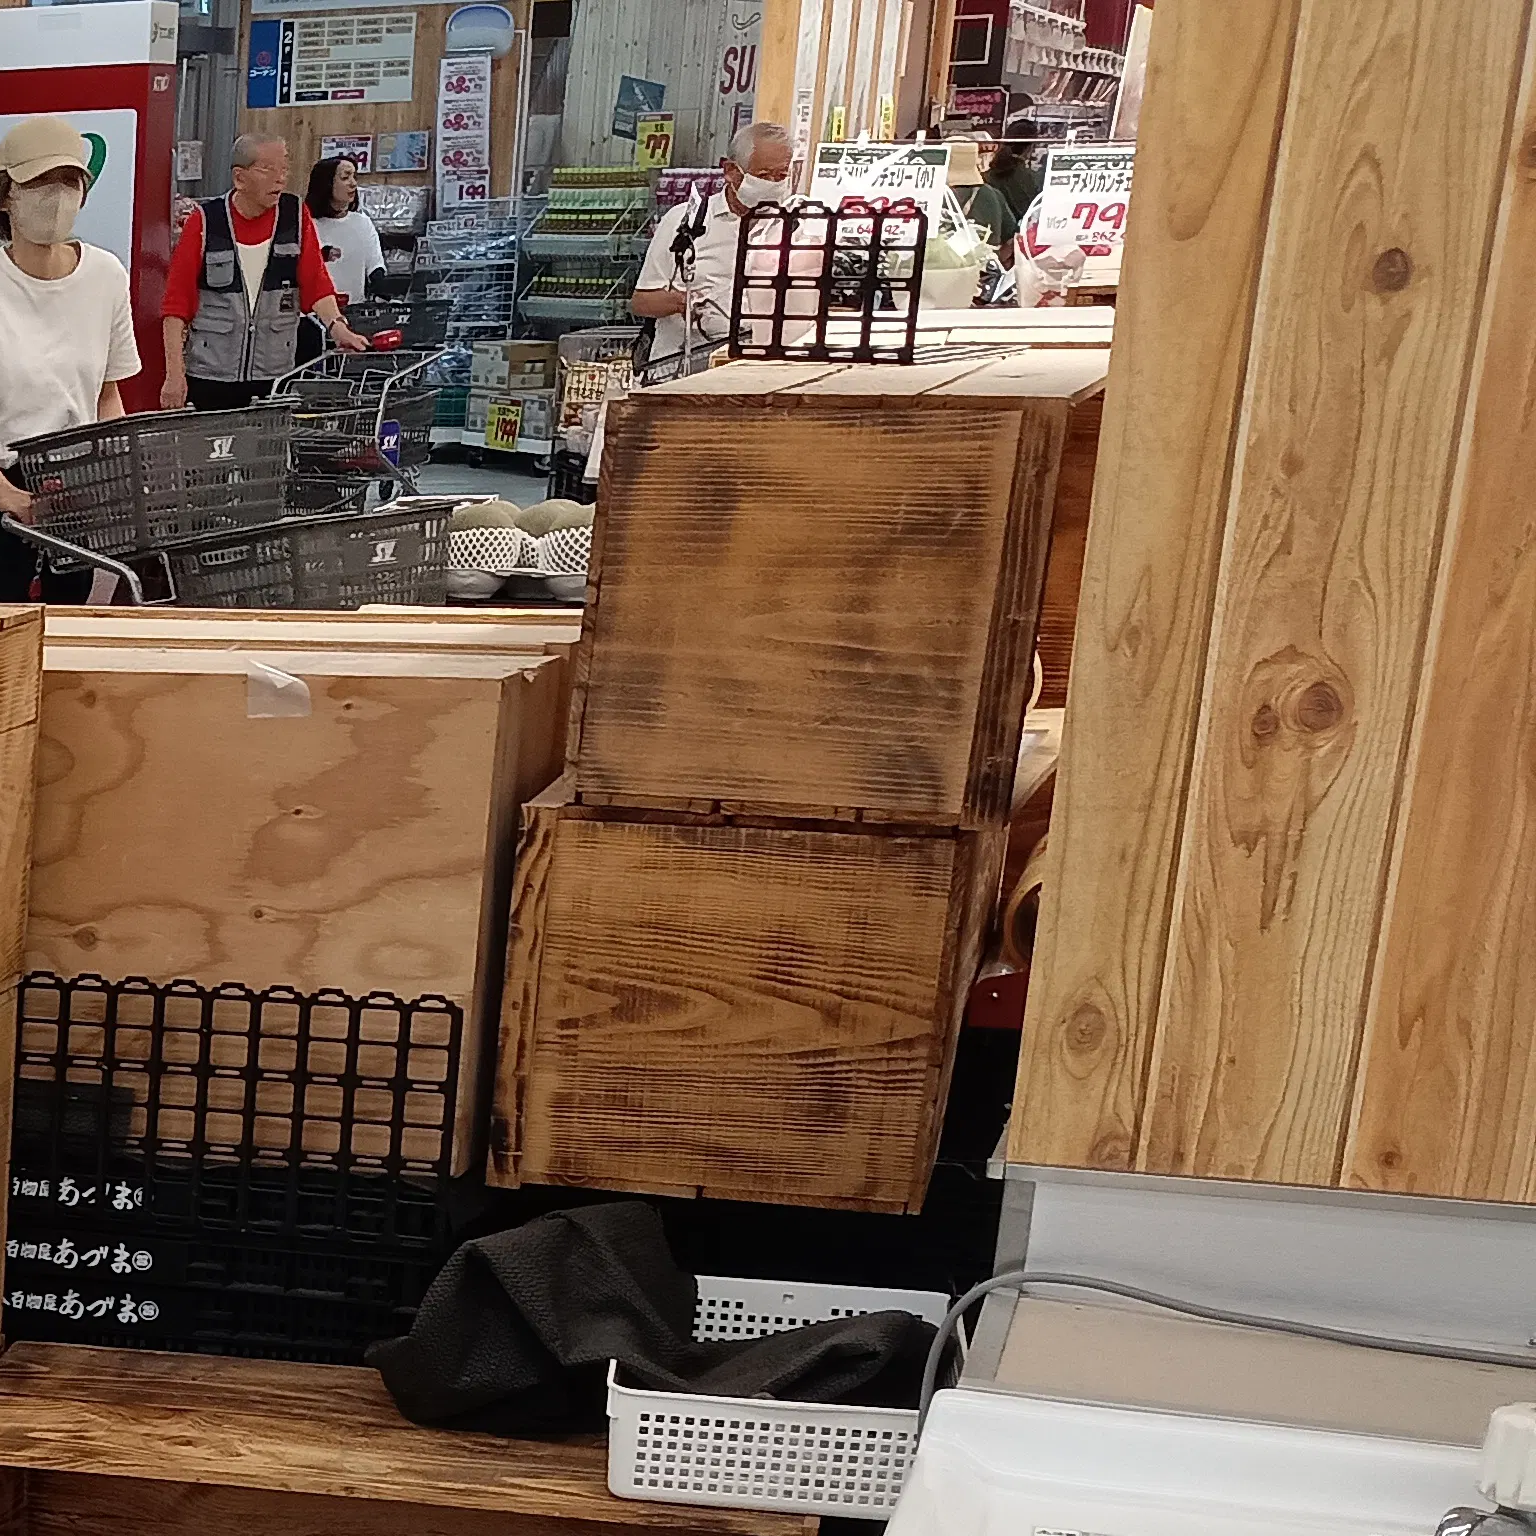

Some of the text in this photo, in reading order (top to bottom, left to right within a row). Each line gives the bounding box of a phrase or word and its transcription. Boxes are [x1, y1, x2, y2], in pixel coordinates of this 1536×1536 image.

[719, 44, 757, 95] SU
[1071, 202, 1127, 230] 79
[3, 1288, 140, 1324] 百物屋あづま
